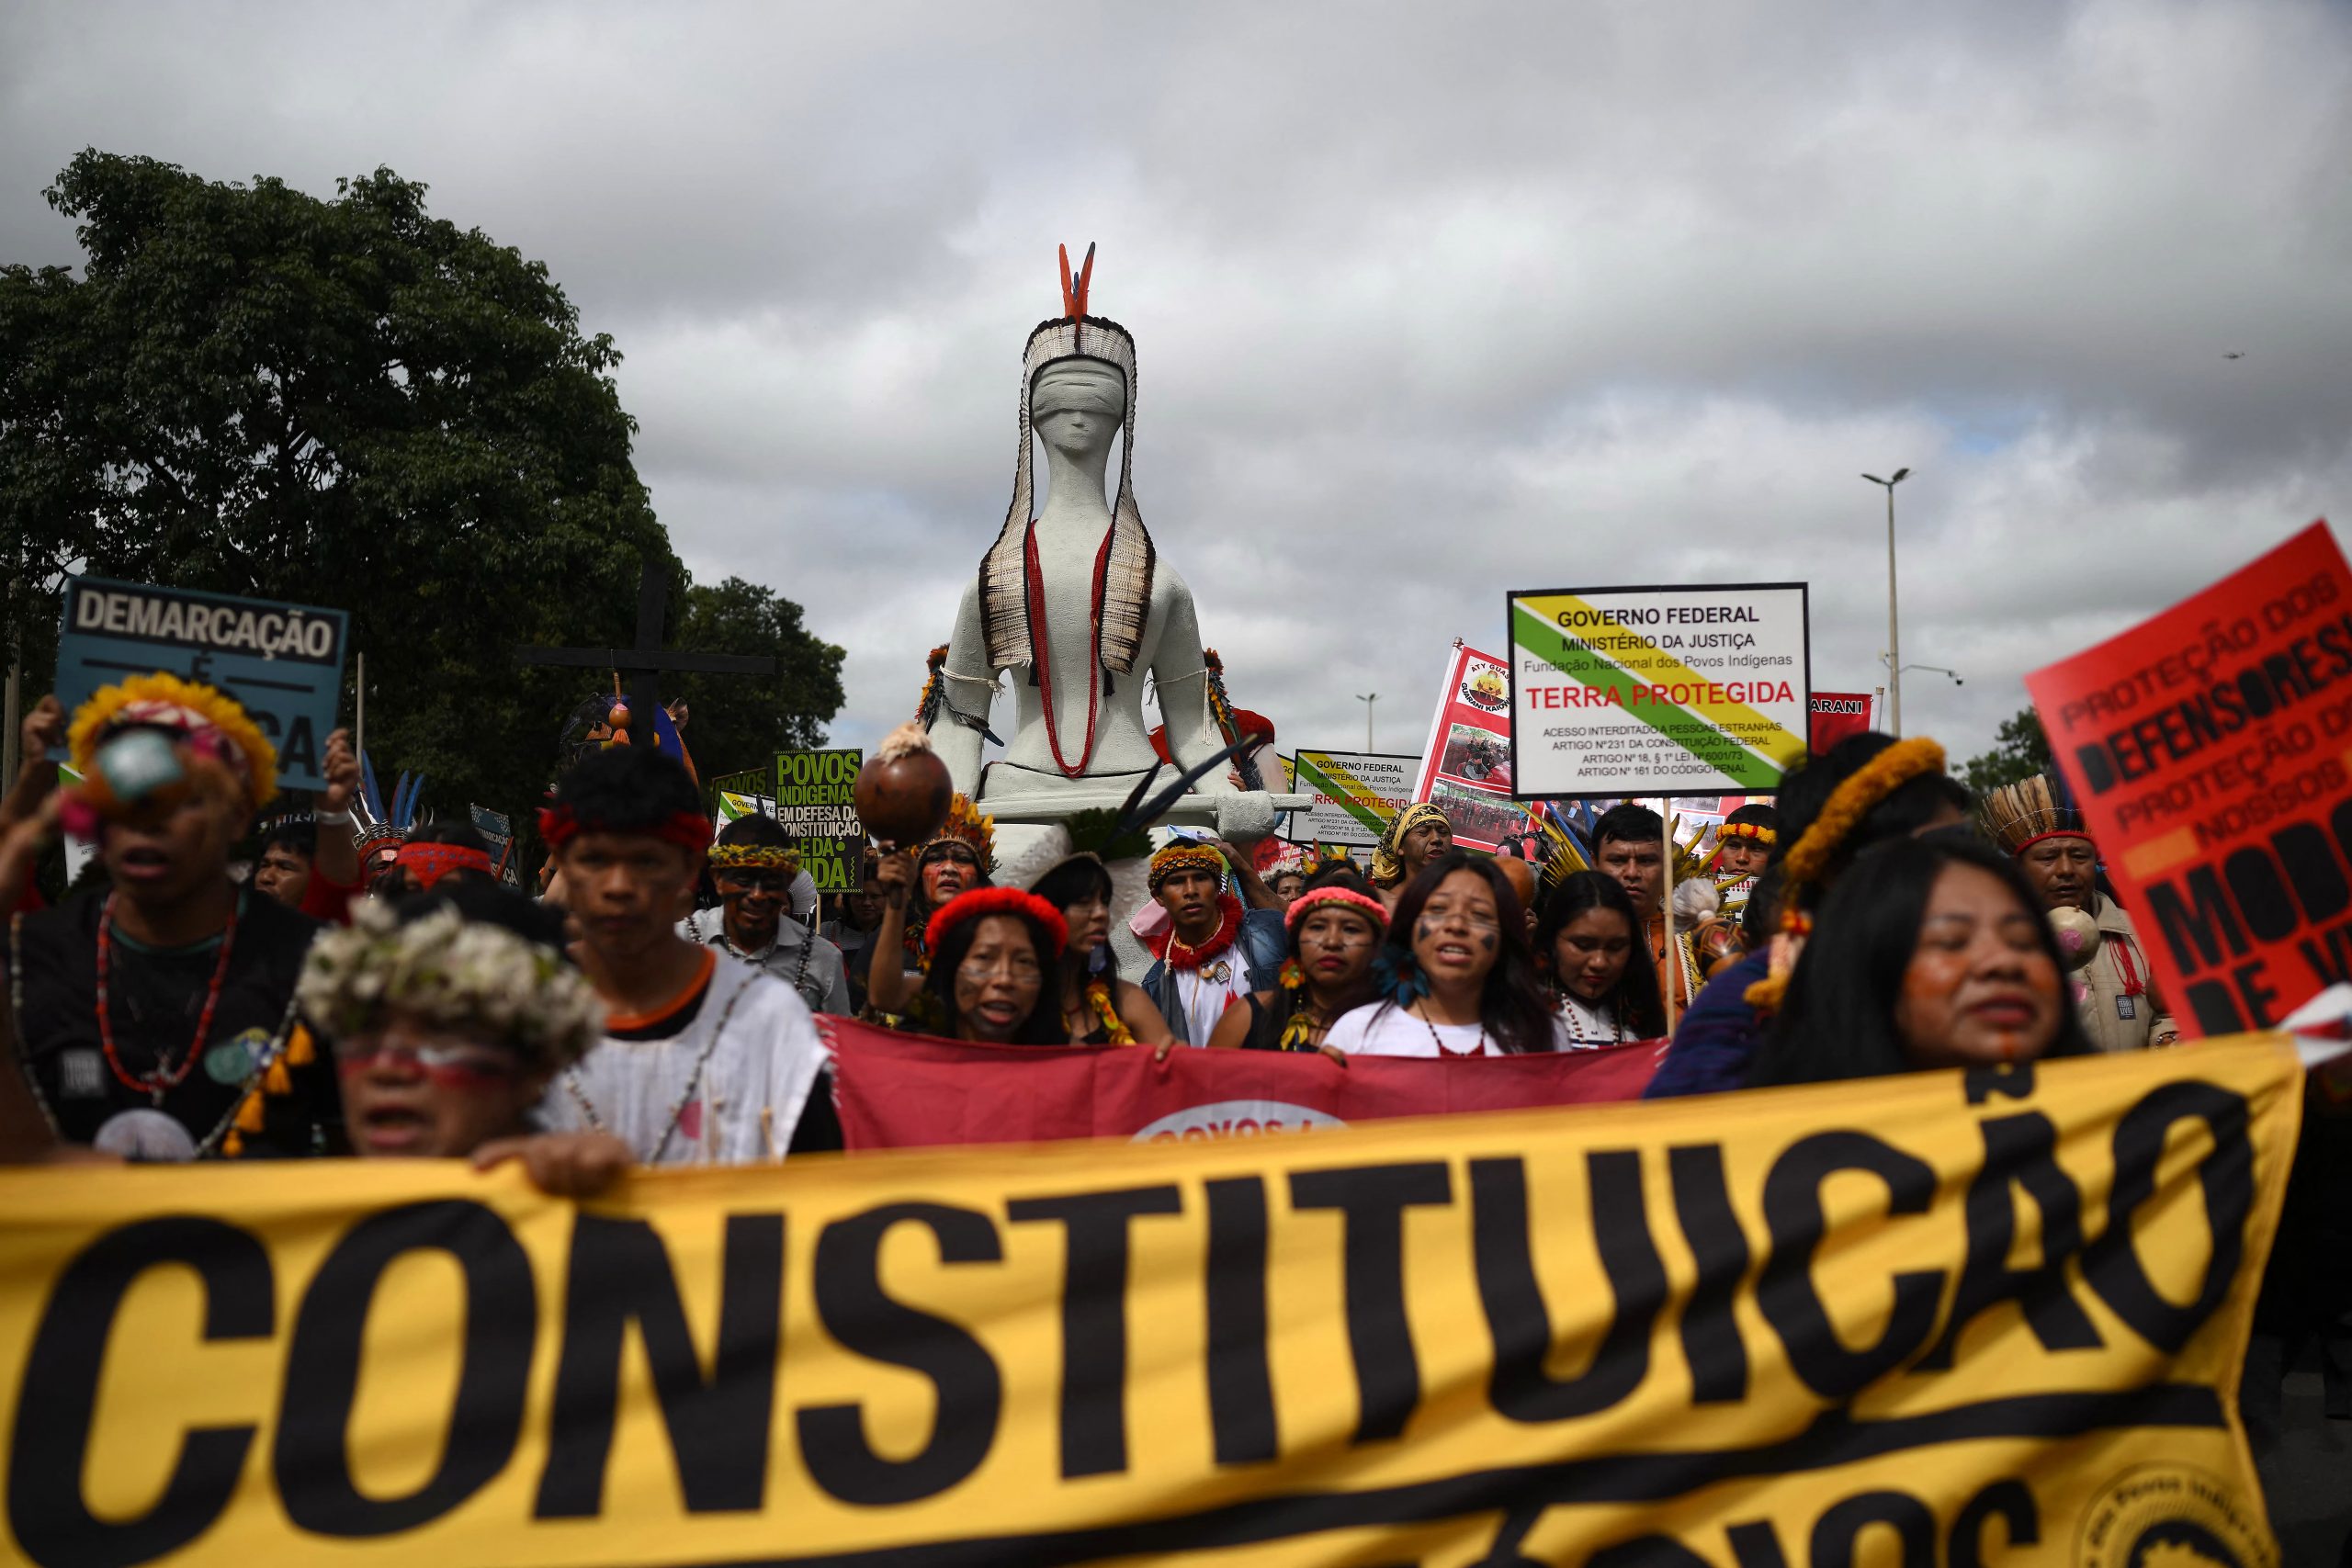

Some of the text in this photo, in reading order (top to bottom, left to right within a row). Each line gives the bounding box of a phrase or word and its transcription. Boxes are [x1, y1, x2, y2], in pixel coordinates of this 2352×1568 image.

[76, 589, 334, 661] DEMARCAÇÃO
[1557, 606, 1759, 627] GOVERNO FEDERAL
[1562, 633, 1756, 652] MINISTÉRIO DA JUSTIÇA
[2061, 571, 2340, 733] PROTEÇÃO DOS
[1471, 662, 1487, 673] ATY
[1524, 654, 1793, 674] Fundação Nacional dos Povos Indígenas
[1461, 682, 1484, 710] GUARANI
[1525, 681, 1794, 709] TERRA PROTEGIDA
[1543, 722, 1783, 737] ACESSO INTERDITADO A PESSOAS ESTRANHAS
[1552, 740, 1593, 750] ARTIGO
[1608, 739, 1625, 749] 231
[1629, 739, 1644, 749] DA
[1646, 737, 1721, 749] CONSTITUIÇÃO
[1724, 737, 1771, 746] FEDERAL
[1582, 754, 1623, 763] ARTIGO
[1638, 753, 1651, 763] 18,
[1675, 752, 1690, 761] LEI
[1705, 750, 1744, 761] 6001/73
[776, 752, 860, 785] POVOS
[1317, 761, 1404, 773] GOVERNO FEDERAL
[1577, 767, 1618, 777] ARTIGO
[1634, 766, 1650, 775] 161
[1654, 765, 1669, 775] DO
[1671, 763, 1713, 774] CÓDIGO
[1713, 764, 1748, 773] PENAL
[1317, 772, 1402, 784] MINISTÉRIO DA JUSTIÇA
[2113, 720, 2317, 835] PROTEÇÃO
[2195, 755, 2346, 851] NOSSOS
[776, 807, 794, 822] EM
[796, 806, 841, 822] DEFESA
[843, 806, 859, 821] DA
[780, 820, 862, 840] ONSTITUIÇÃO
[800, 837, 835, 857] E DA
[2184, 961, 2283, 1038] DE
[7, 1063, 2256, 1568] CONSTITUIÇÃO
